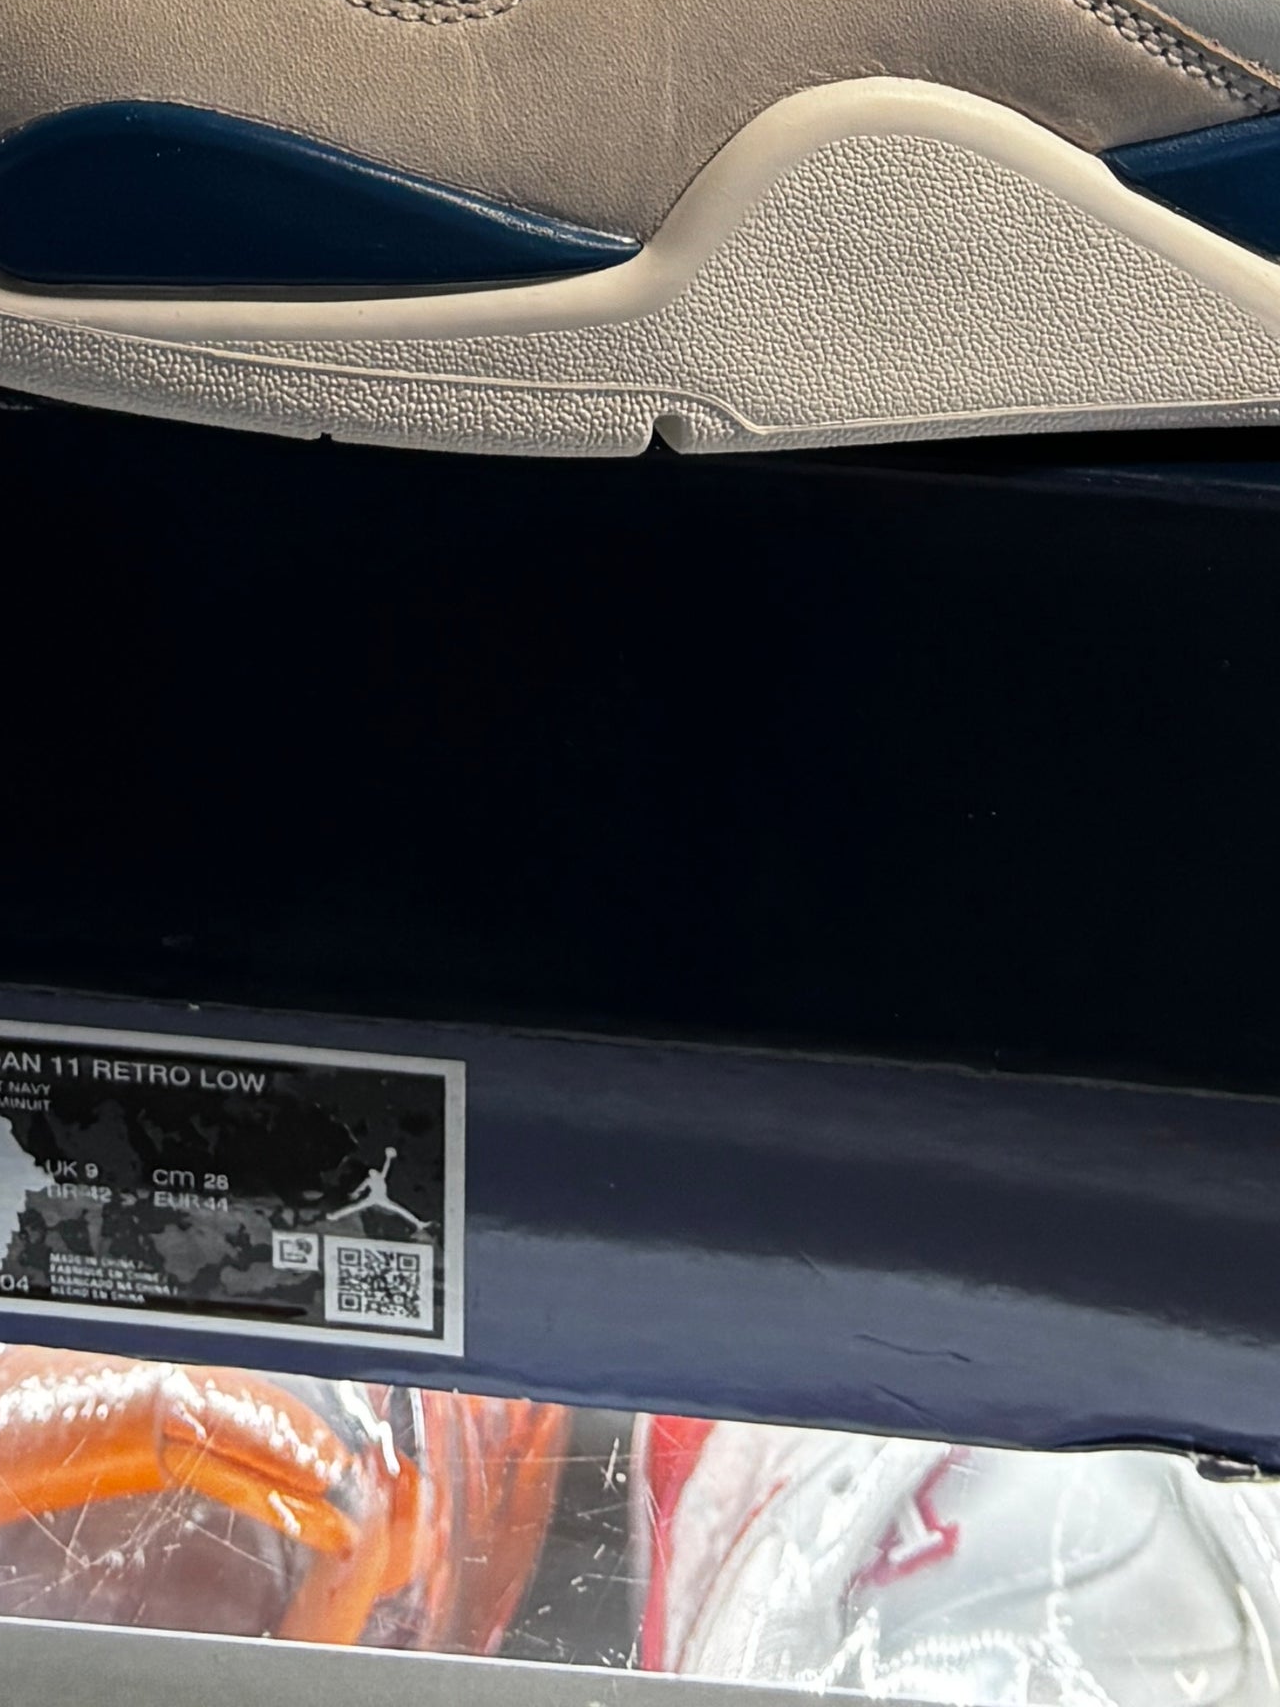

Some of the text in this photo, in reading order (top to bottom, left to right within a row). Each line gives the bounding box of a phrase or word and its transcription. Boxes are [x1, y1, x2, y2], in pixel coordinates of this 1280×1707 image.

[51, 1056, 78, 1077] 11
[93, 1059, 190, 1086] RETRO
[200, 1068, 265, 1093] LOW
[9, 1081, 50, 1095] NAVY
[46, 1159, 99, 1179] UK 9
[204, 1173, 229, 1190] 28
[153, 1191, 201, 1211] EUR
